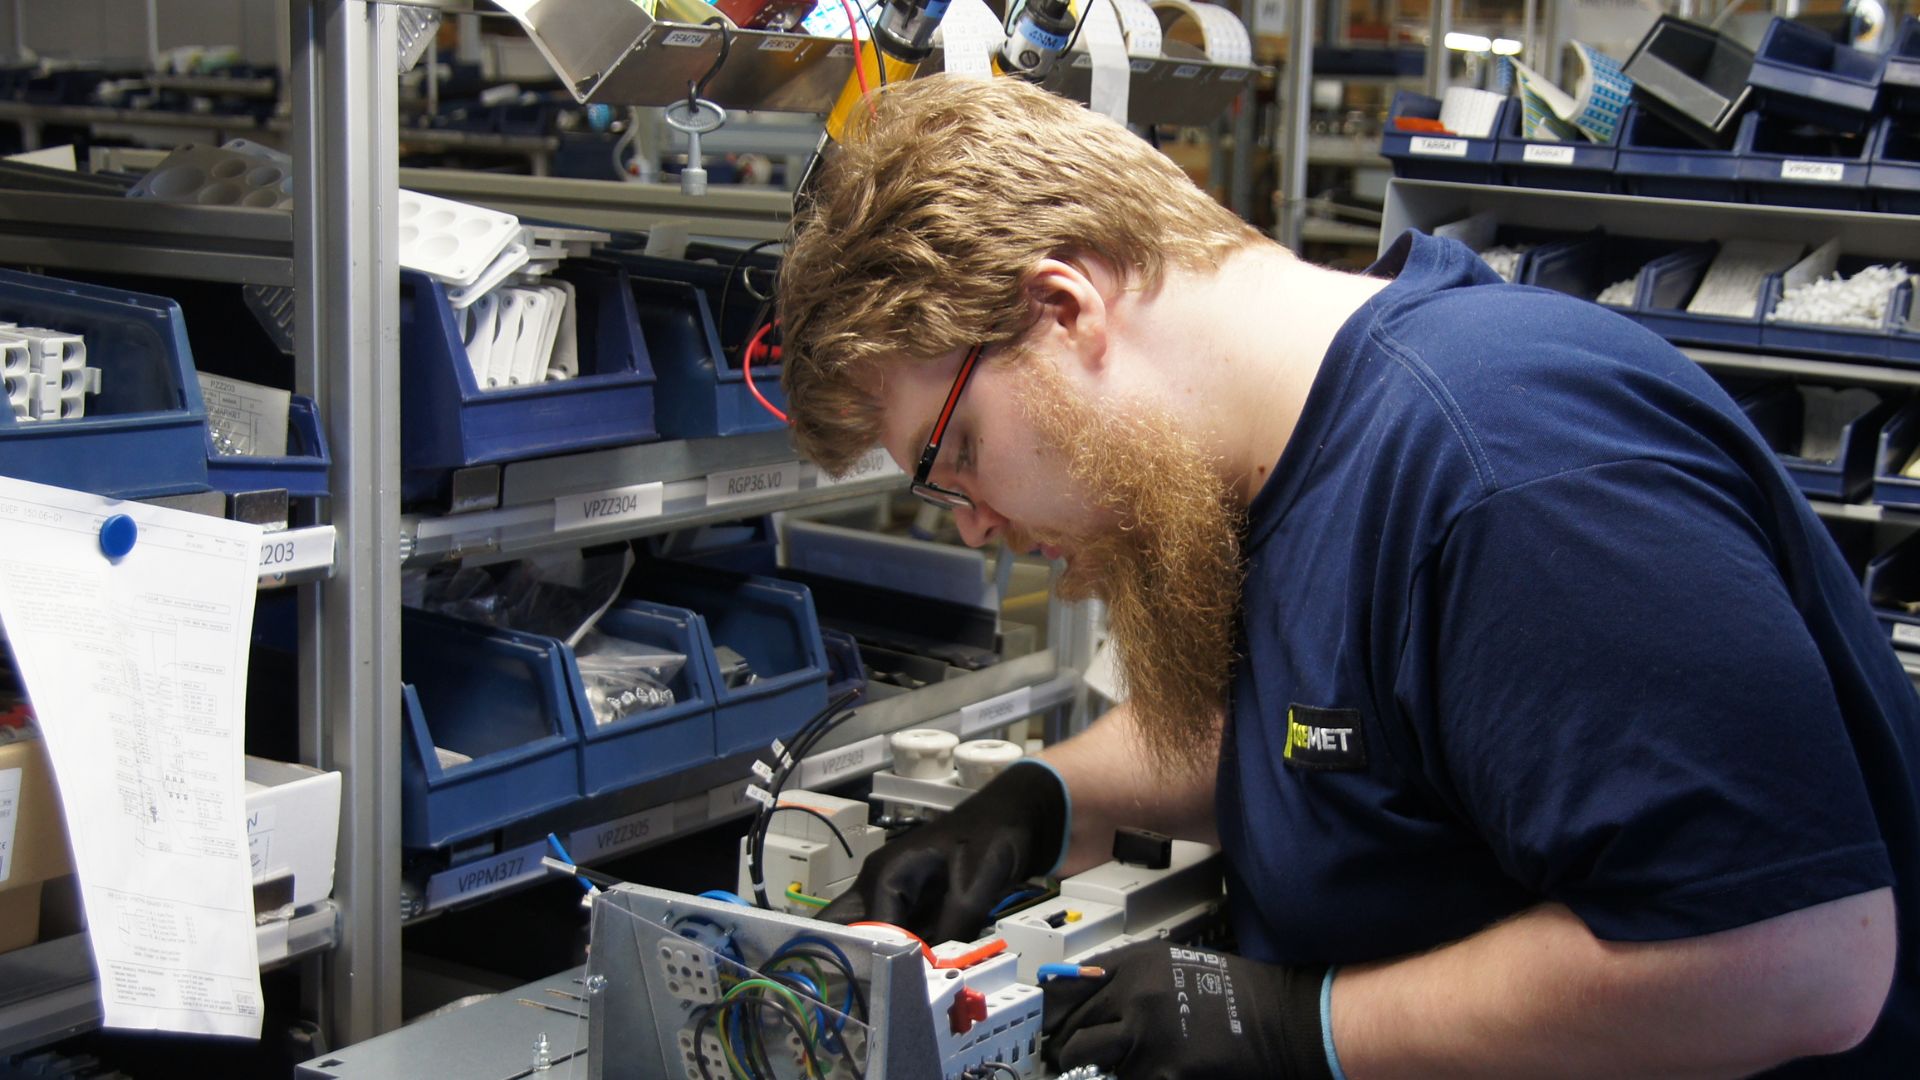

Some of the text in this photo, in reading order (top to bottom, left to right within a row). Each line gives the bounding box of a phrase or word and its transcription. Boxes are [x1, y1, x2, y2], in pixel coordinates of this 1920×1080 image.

[728, 472, 782, 494] RGP36.V0
[583, 494, 637, 519] VPZZ304
[458, 856, 525, 893] VPPM377
[1170, 947, 1220, 965] GUIDE
